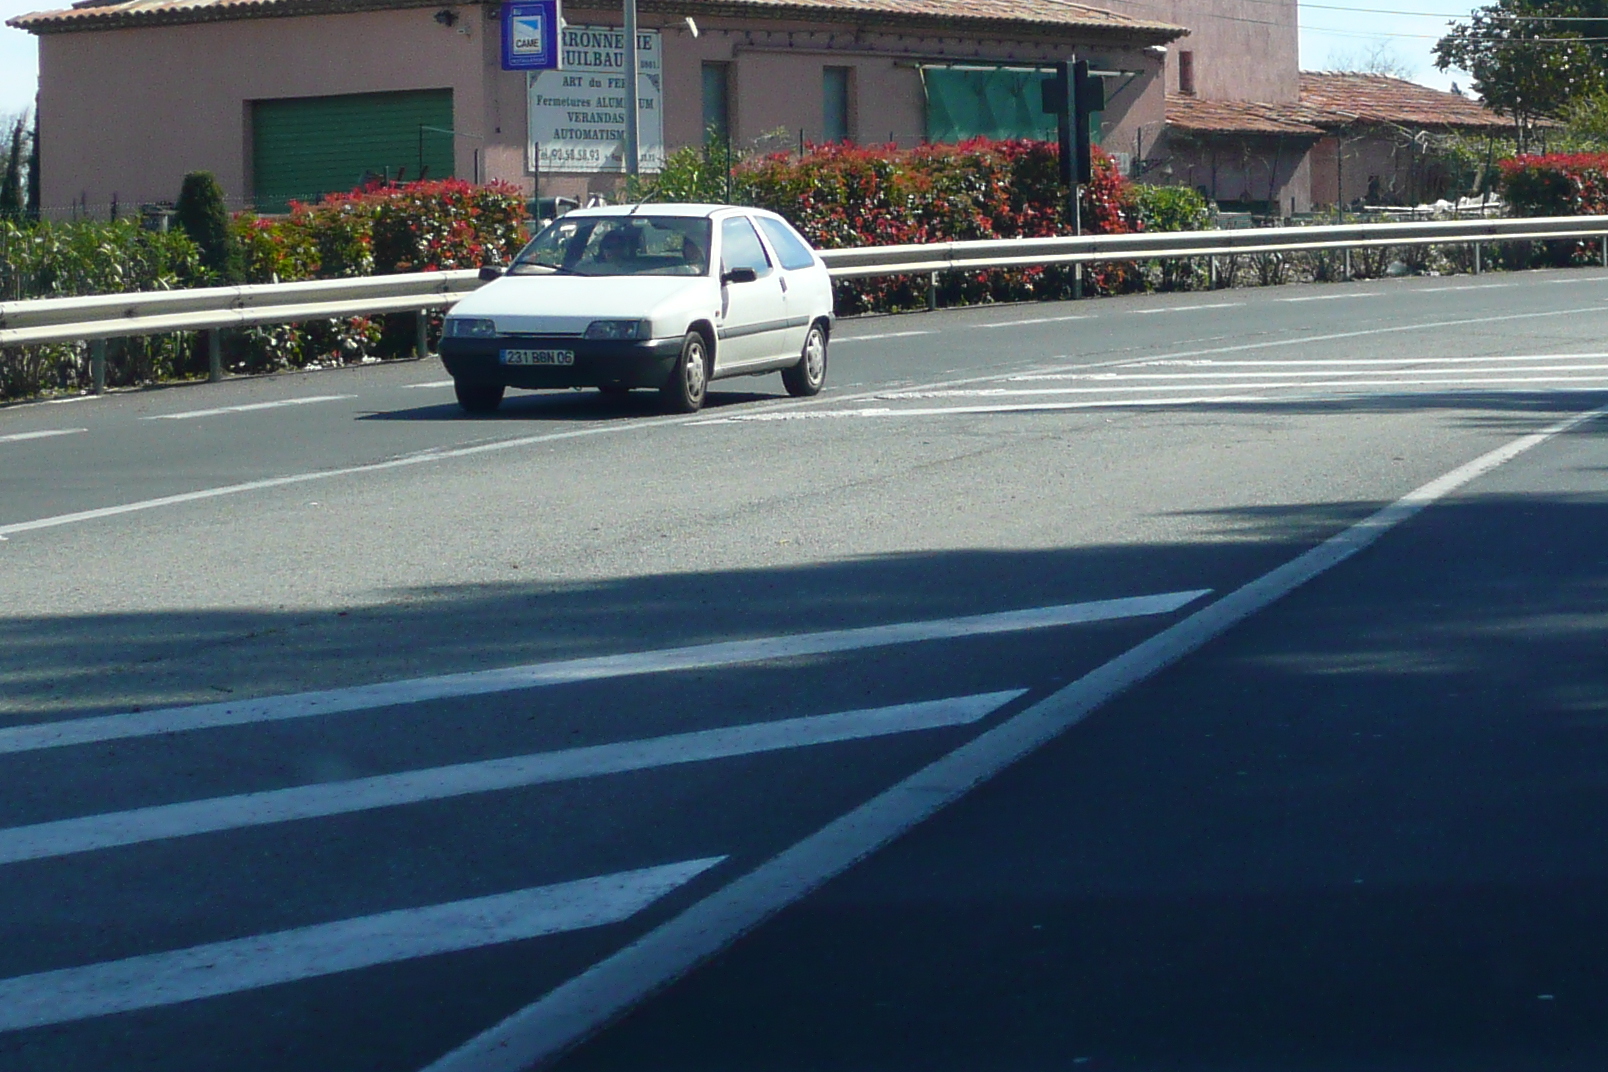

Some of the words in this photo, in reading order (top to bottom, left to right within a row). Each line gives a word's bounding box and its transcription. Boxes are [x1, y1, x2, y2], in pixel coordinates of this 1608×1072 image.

[515, 38, 540, 48] CAME
[562, 76, 583, 87] ART
[588, 77, 602, 88] du
[536, 95, 591, 107] Fermetures
[595, 97, 654, 109] ALUMUM
[566, 112, 625, 124] VERANDAS
[553, 128, 625, 140] AUTOMATISM
[507, 350, 529, 364] 231
[557, 350, 573, 364] 06
